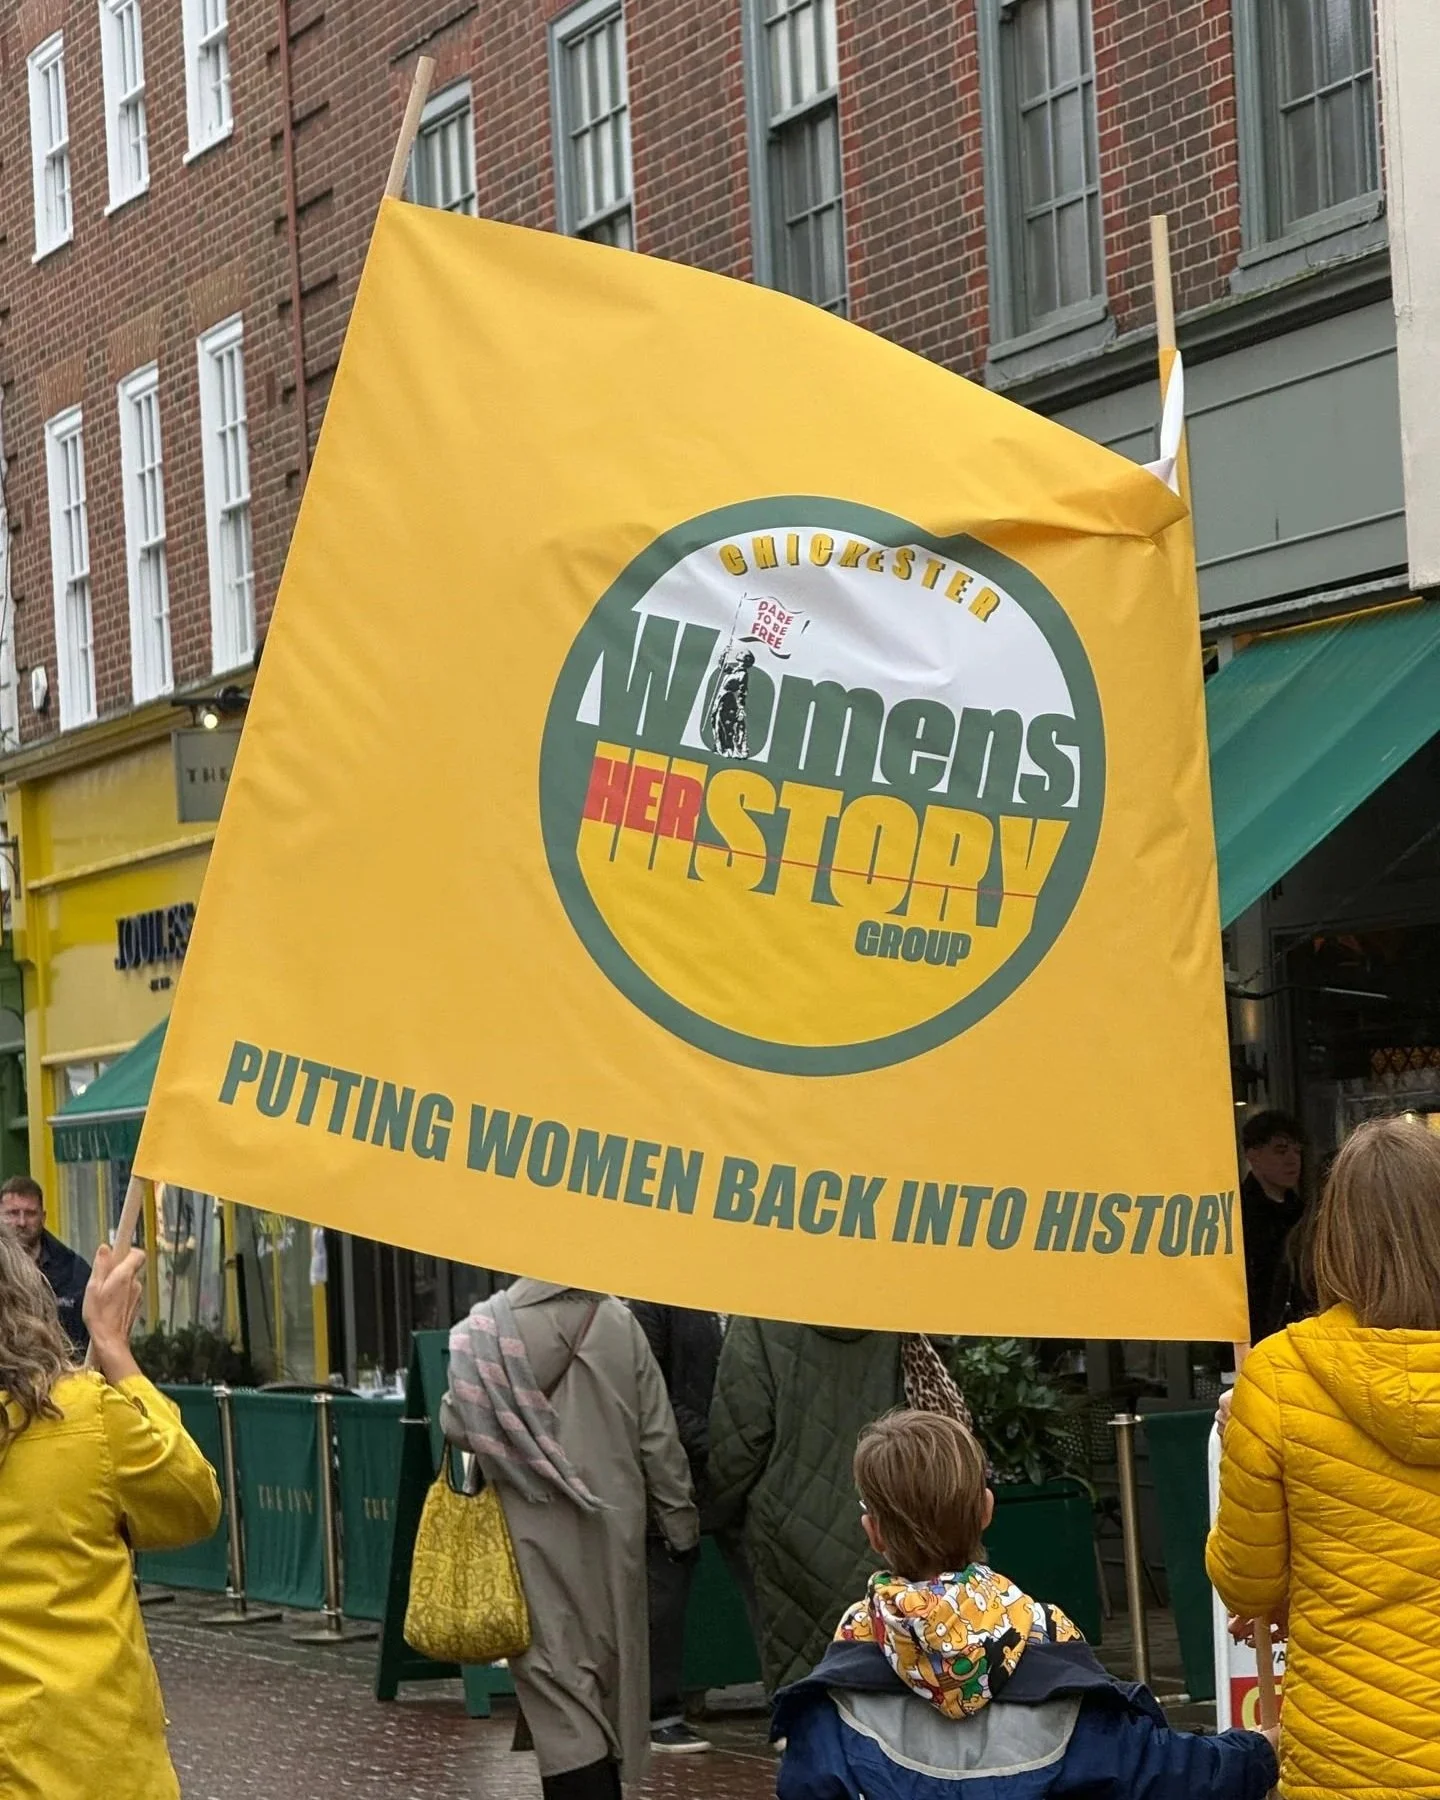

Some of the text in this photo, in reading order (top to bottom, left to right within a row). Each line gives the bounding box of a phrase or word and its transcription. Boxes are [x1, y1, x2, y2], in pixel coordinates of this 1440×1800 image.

[757, 612, 788, 636] TO BE
[758, 600, 794, 625] DARE
[751, 622, 783, 649] FREE
[854, 919, 972, 967] GROUP
[218, 1040, 1236, 1258] PUTTING WOMEN BACK INTO HISTORY
